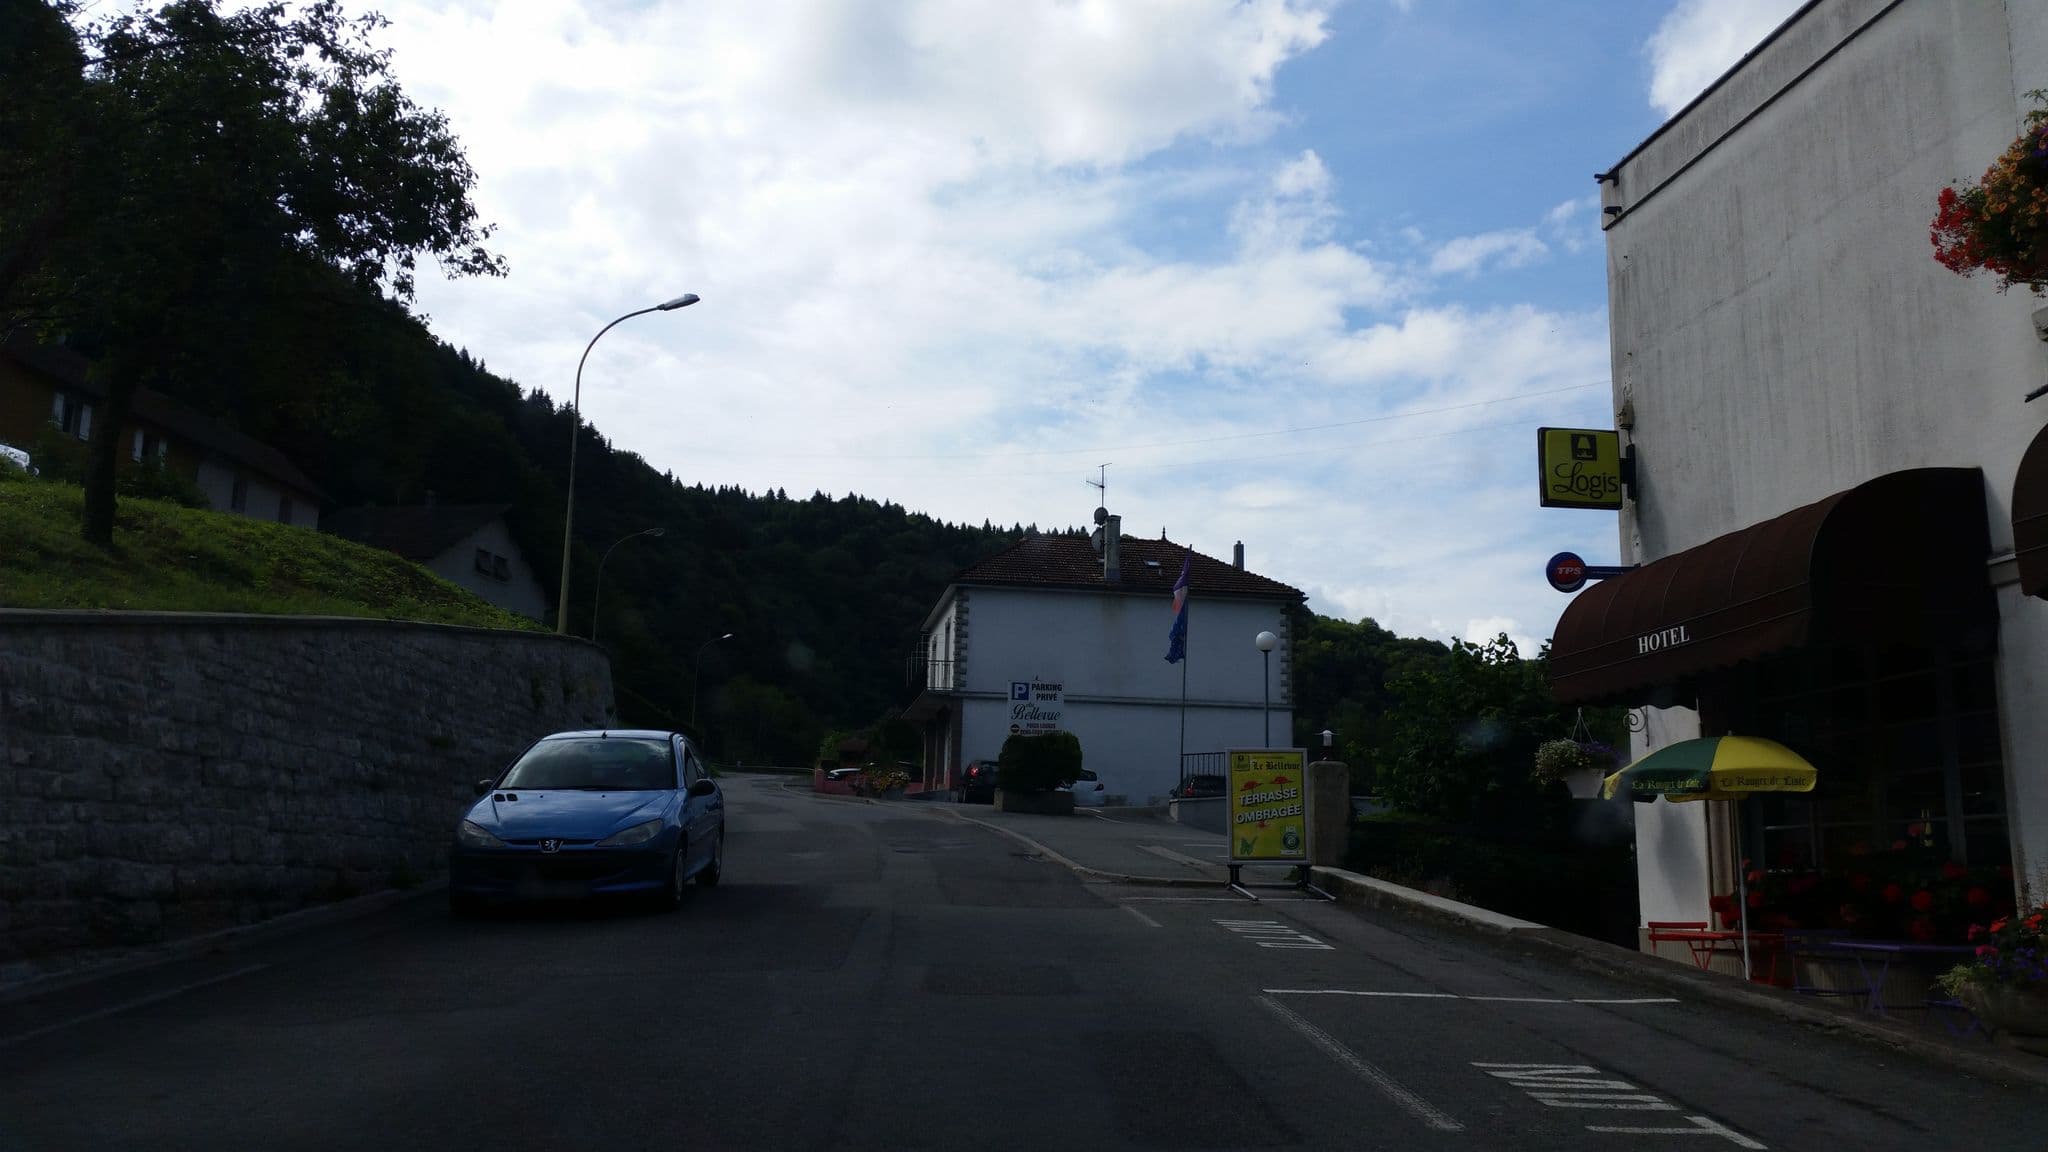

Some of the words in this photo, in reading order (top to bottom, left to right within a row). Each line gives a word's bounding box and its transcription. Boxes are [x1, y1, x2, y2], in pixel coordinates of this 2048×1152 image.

[1553, 462, 1618, 499] Logis
[1557, 566, 1581, 575] TPS
[1638, 626, 1690, 653] HOTEL
[1015, 683, 1027, 699] P
[1031, 683, 1062, 691] PARKING
[1011, 704, 1061, 720] Bellevue
[1251, 761, 1263, 770] Le
[1266, 761, 1300, 770] Bellevue
[1240, 788, 1297, 806] TERRASSE
